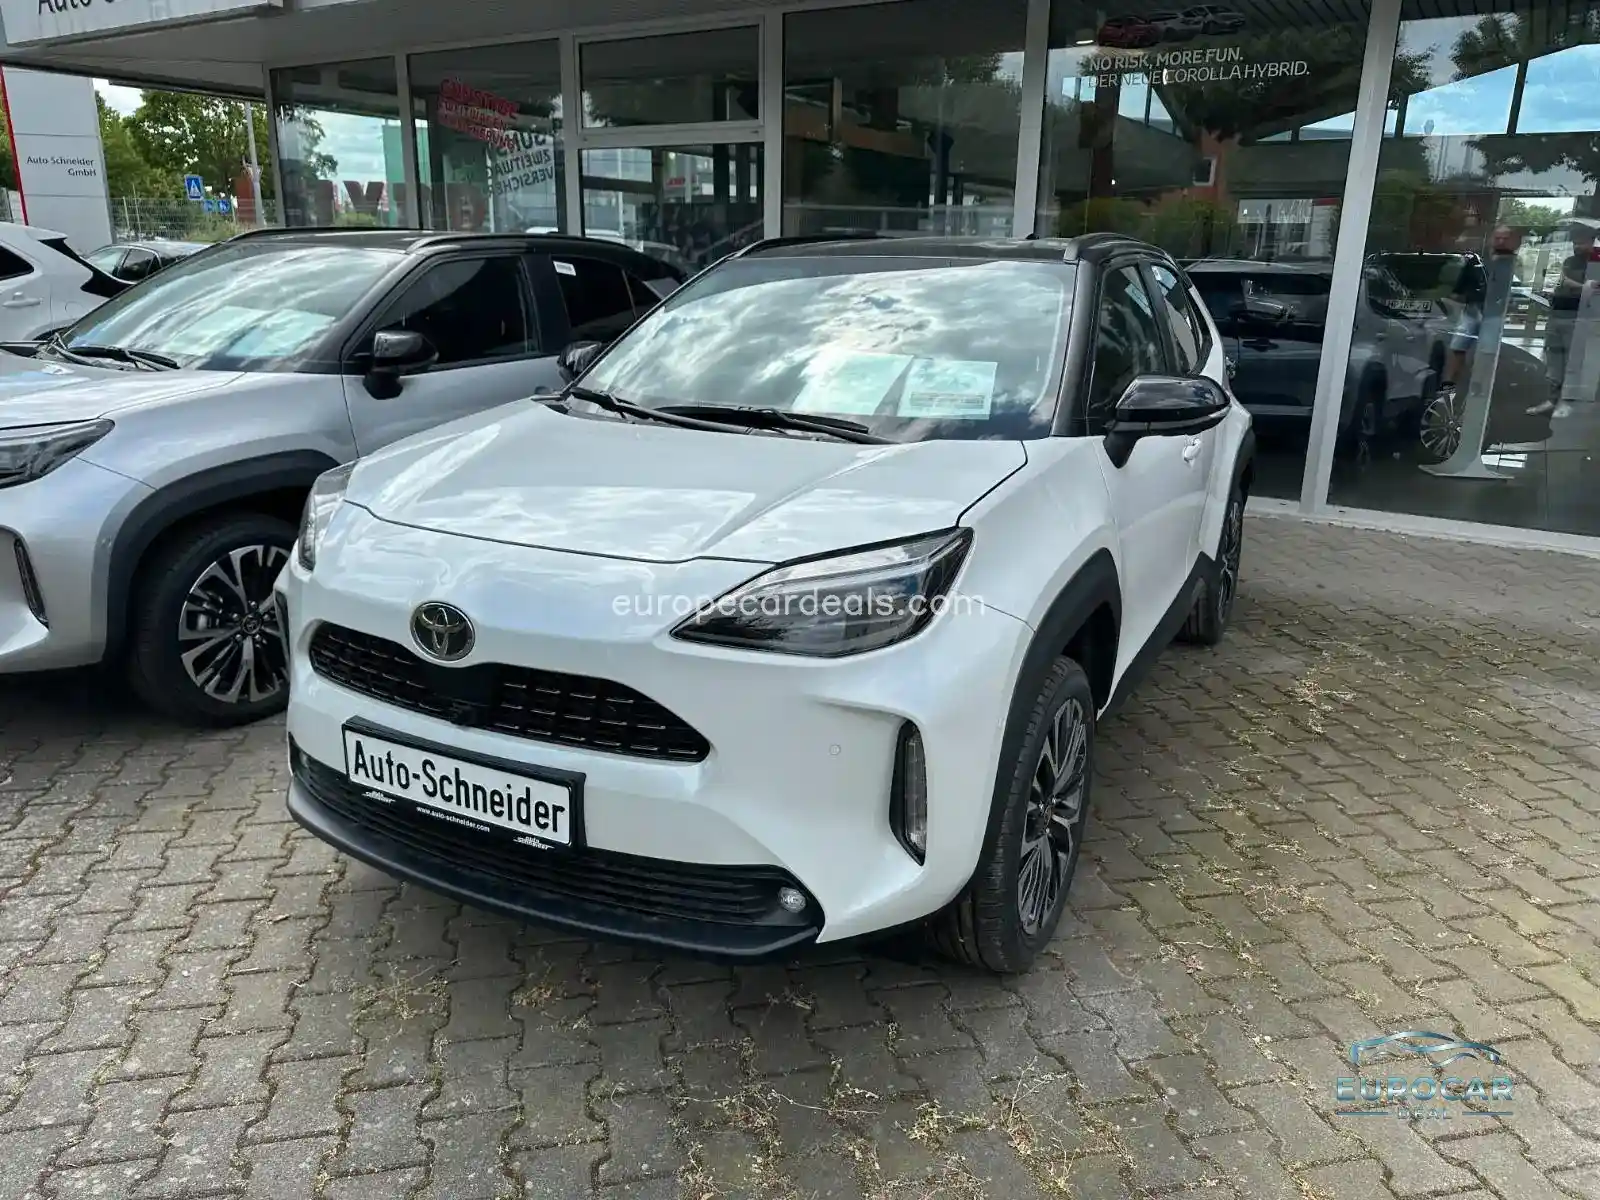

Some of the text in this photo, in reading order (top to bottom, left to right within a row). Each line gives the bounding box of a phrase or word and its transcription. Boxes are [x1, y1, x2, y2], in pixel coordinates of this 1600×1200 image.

[1090, 47, 1243, 71] NO RISK, MORE FUN.
[1088, 60, 1310, 88] DER NEUE COROLLA HYBRID.
[67, 168, 97, 177] GmbH
[354, 740, 566, 833] Auto-Schneider
[416, 806, 491, 833] www.auto-schneider.com
